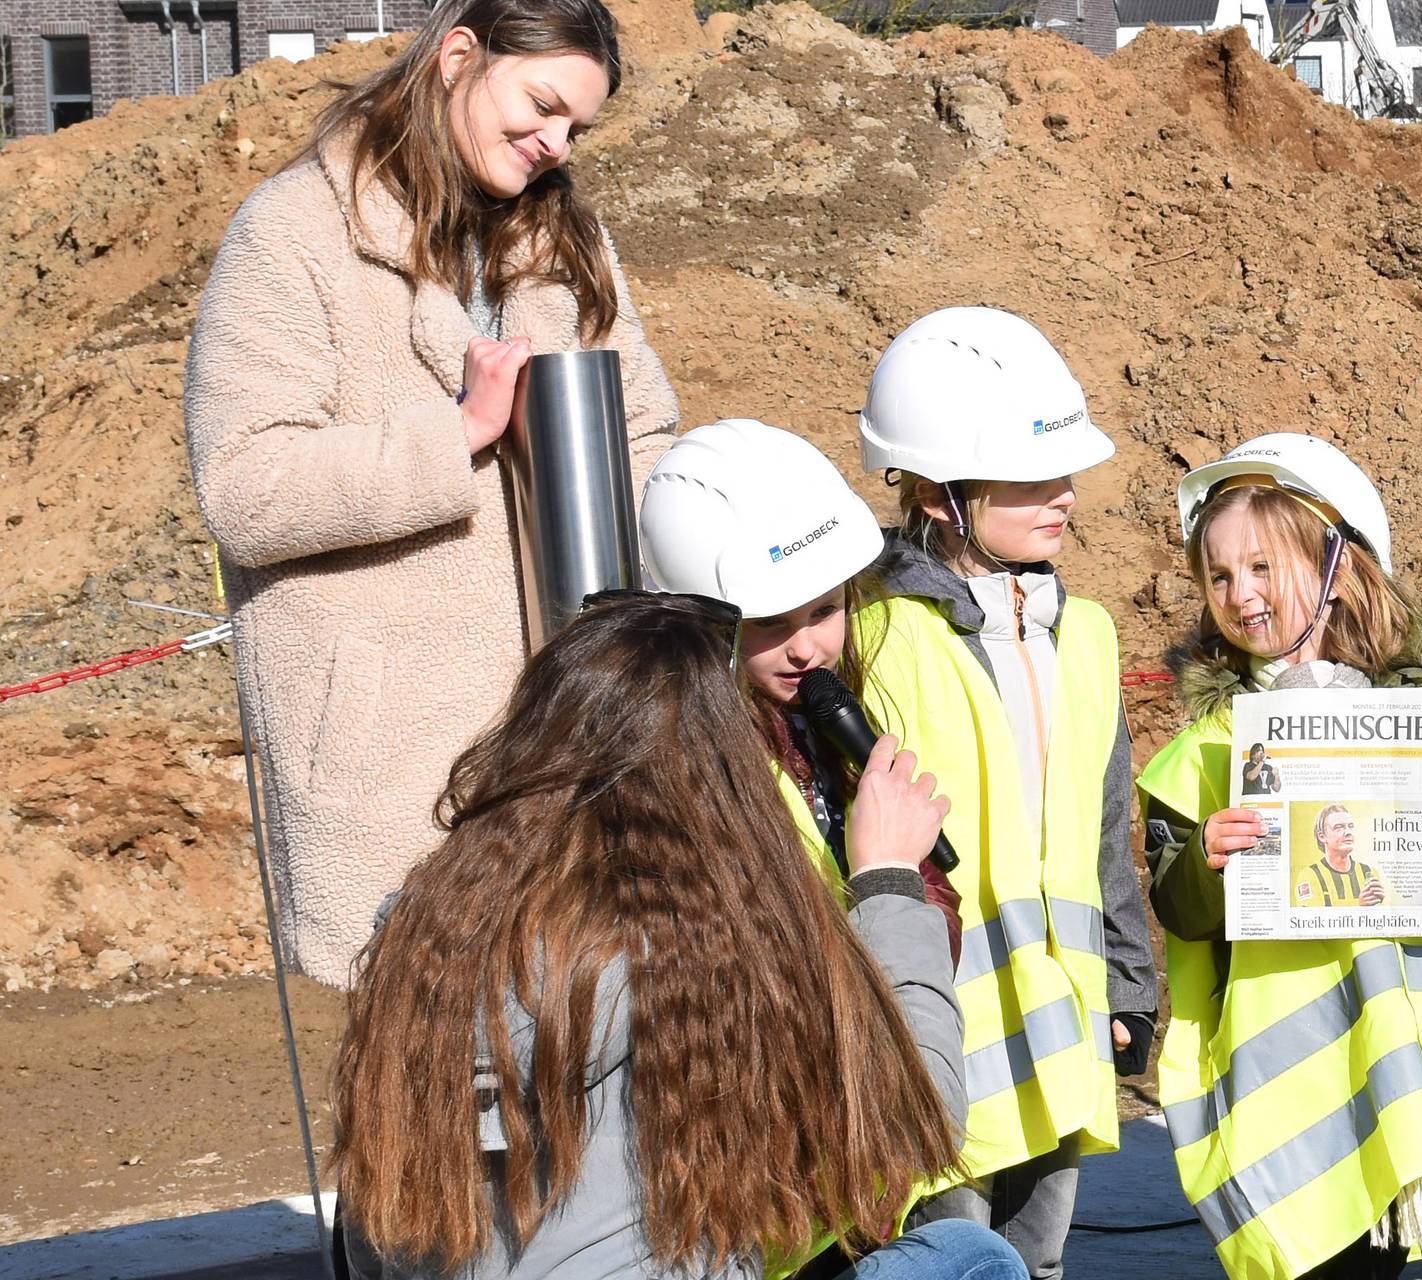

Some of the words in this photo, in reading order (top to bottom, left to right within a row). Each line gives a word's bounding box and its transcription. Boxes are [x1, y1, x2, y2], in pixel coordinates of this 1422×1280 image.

[1044, 409, 1085, 433] GOLDBECK
[782, 516, 839, 557] GOLDBECK
[1373, 837, 1391, 852] im
[1289, 916, 1325, 930] Streik
[1328, 914, 1355, 929] trifft
[1358, 914, 1420, 930] Flughäfen,
